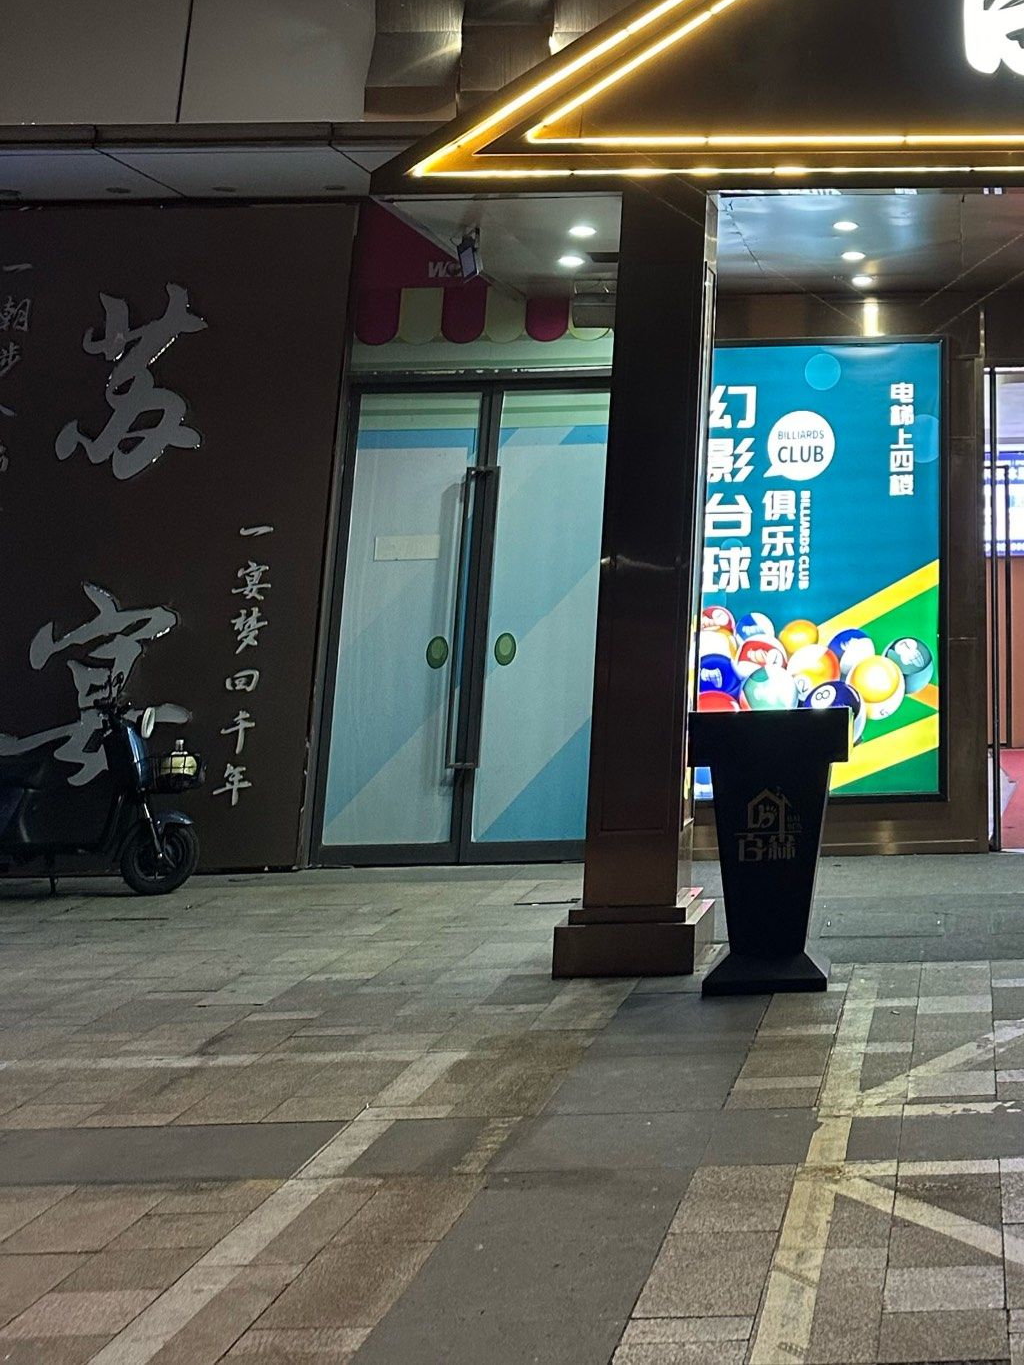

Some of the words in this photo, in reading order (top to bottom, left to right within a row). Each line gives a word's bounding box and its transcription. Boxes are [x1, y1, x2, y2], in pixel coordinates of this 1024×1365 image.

[777, 445, 824, 463] CLUB
[778, 430, 825, 440] BILLIARDS
[889, 382, 915, 496] 电梯上四楼
[702, 385, 757, 593] 幻影台球
[759, 490, 796, 592] 俱乐部
[799, 490, 811, 554] BILLIARDS
[798, 555, 810, 590] CLUB
[213, 526, 274, 807] 一宴梦回千年
[815, 688, 831, 701] 8
